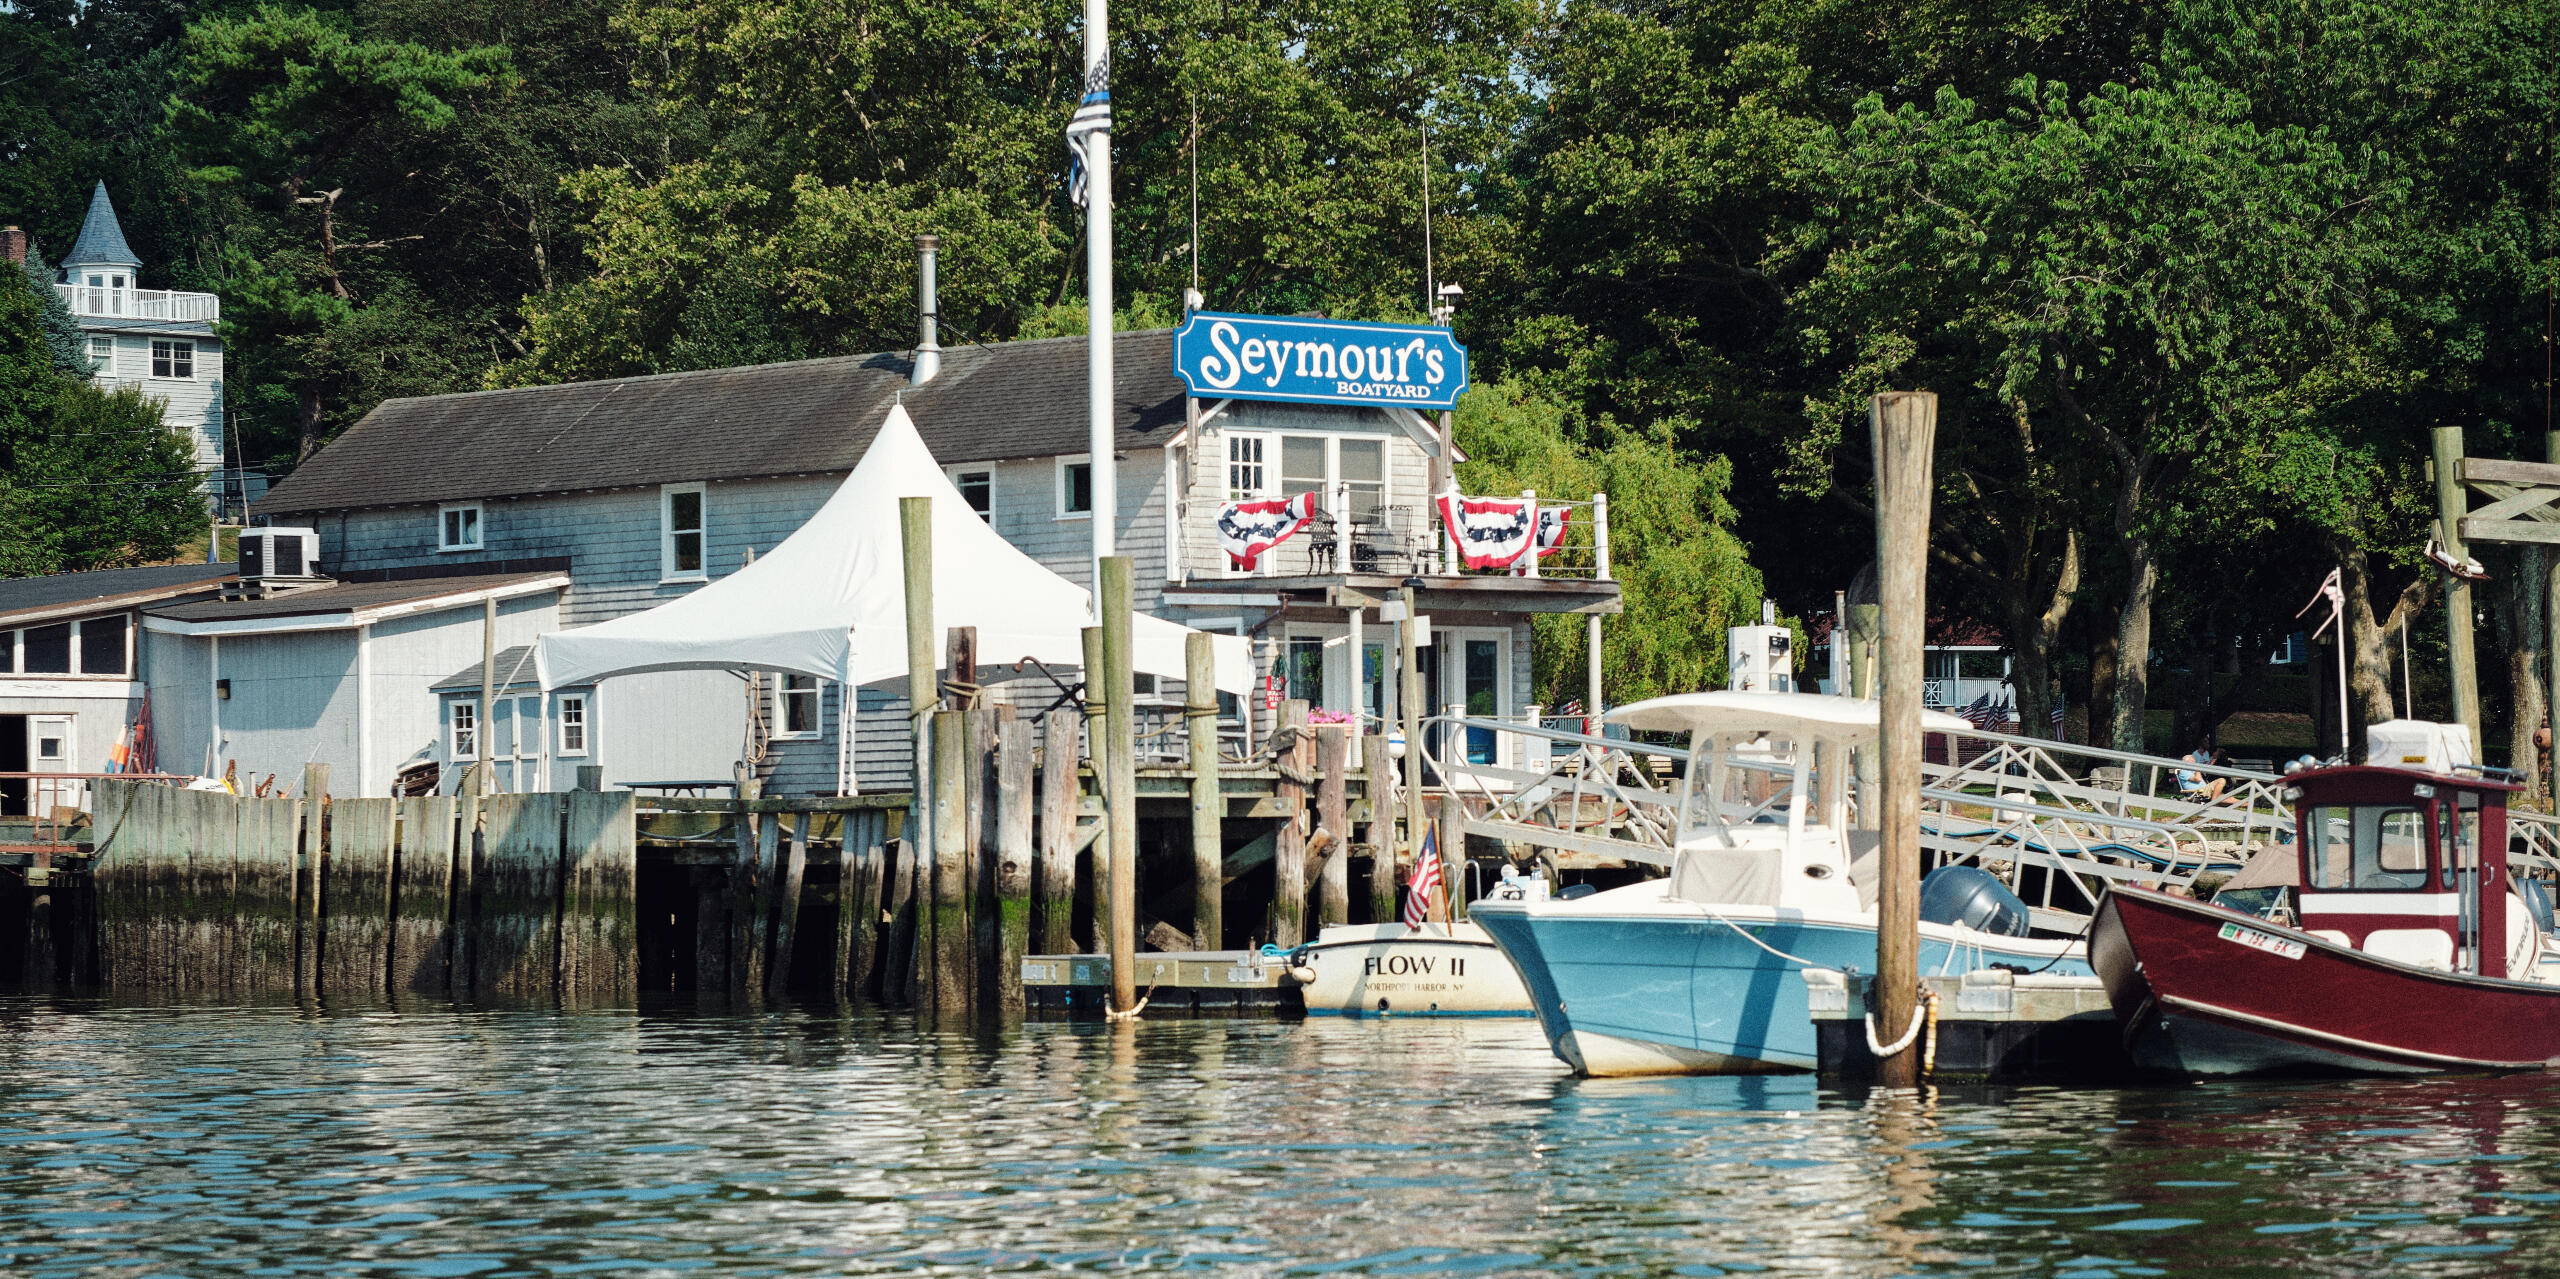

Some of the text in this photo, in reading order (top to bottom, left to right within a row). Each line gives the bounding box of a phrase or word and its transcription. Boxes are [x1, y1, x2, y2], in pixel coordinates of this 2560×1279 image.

[1200, 321, 1445, 389] Seymour's
[1336, 382, 1430, 399] BOATYARD
[1364, 955, 1465, 976] FLOW II
